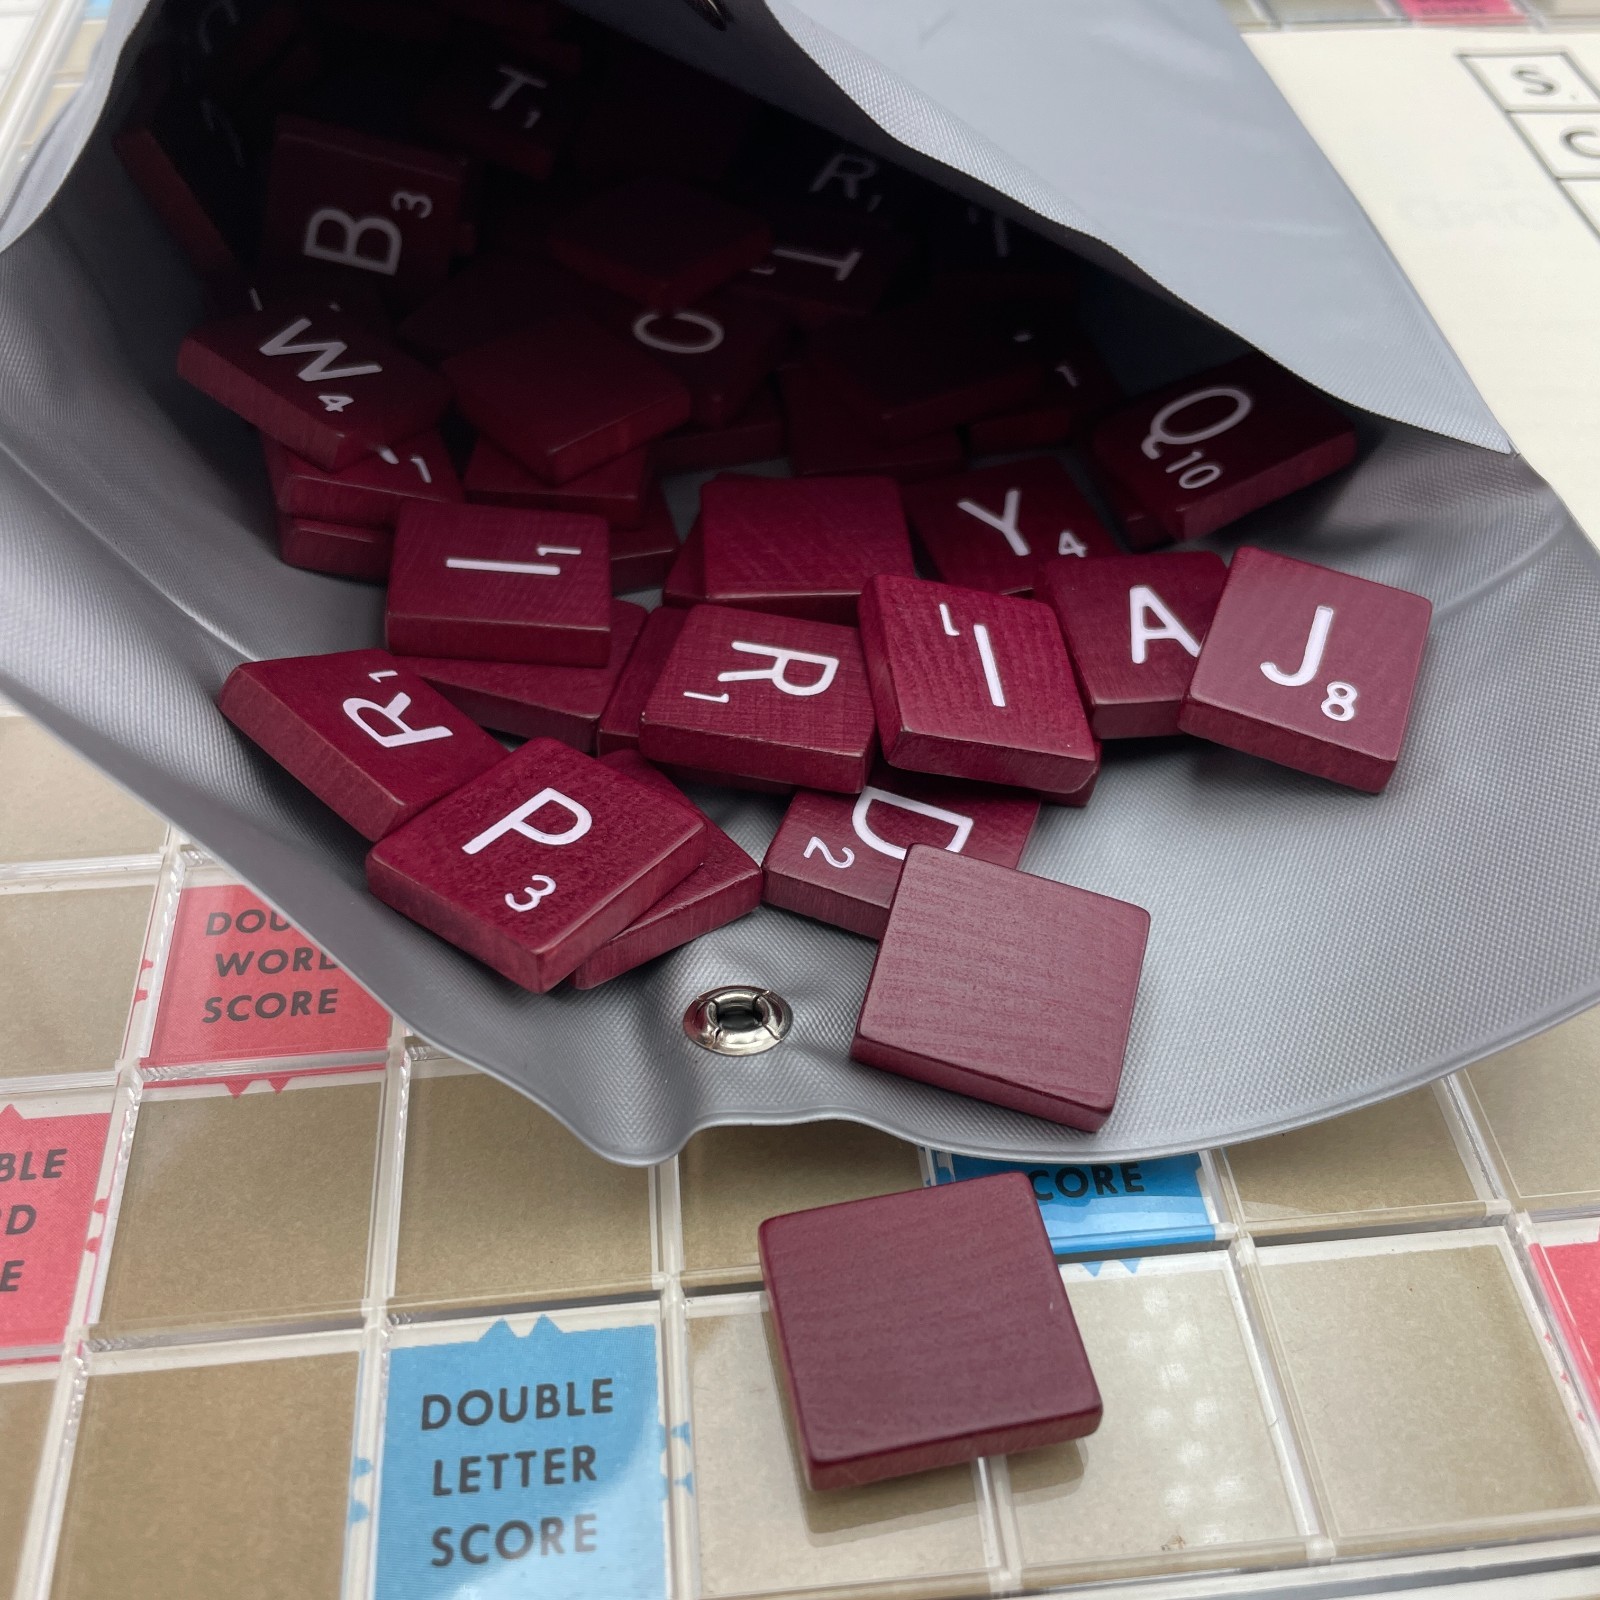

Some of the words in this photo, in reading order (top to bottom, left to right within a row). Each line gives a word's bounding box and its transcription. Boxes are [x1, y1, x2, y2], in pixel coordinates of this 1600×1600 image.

[489, 64, 548, 112] T
[808, 152, 878, 200] R
[303, 207, 402, 276] B
[390, 190, 433, 219] 3
[258, 317, 383, 382] W
[317, 393, 355, 413] 4
[1141, 387, 1252, 460] Q
[1165, 450, 1222, 490] 10
[957, 489, 1030, 556] Y
[1058, 531, 1088, 558] 4
[1129, 585, 1201, 664] A
[717, 639, 840, 697] R
[1260, 605, 1334, 688] J
[1320, 681, 1358, 723] 8
[342, 692, 454, 749] R
[462, 787, 593, 856] P
[852, 786, 974, 861] D
[803, 836, 855, 869] 2
[504, 874, 557, 913] 3
[206, 908, 291, 937] DOU
[202, 987, 340, 1024] SCORE
[0, 1148, 68, 1182] BLE
[1028, 1161, 1145, 1202] CORE
[421, 1377, 614, 1431] DOUBLE
[432, 1444, 598, 1497] LETTER
[431, 1512, 598, 1568] SCORE
